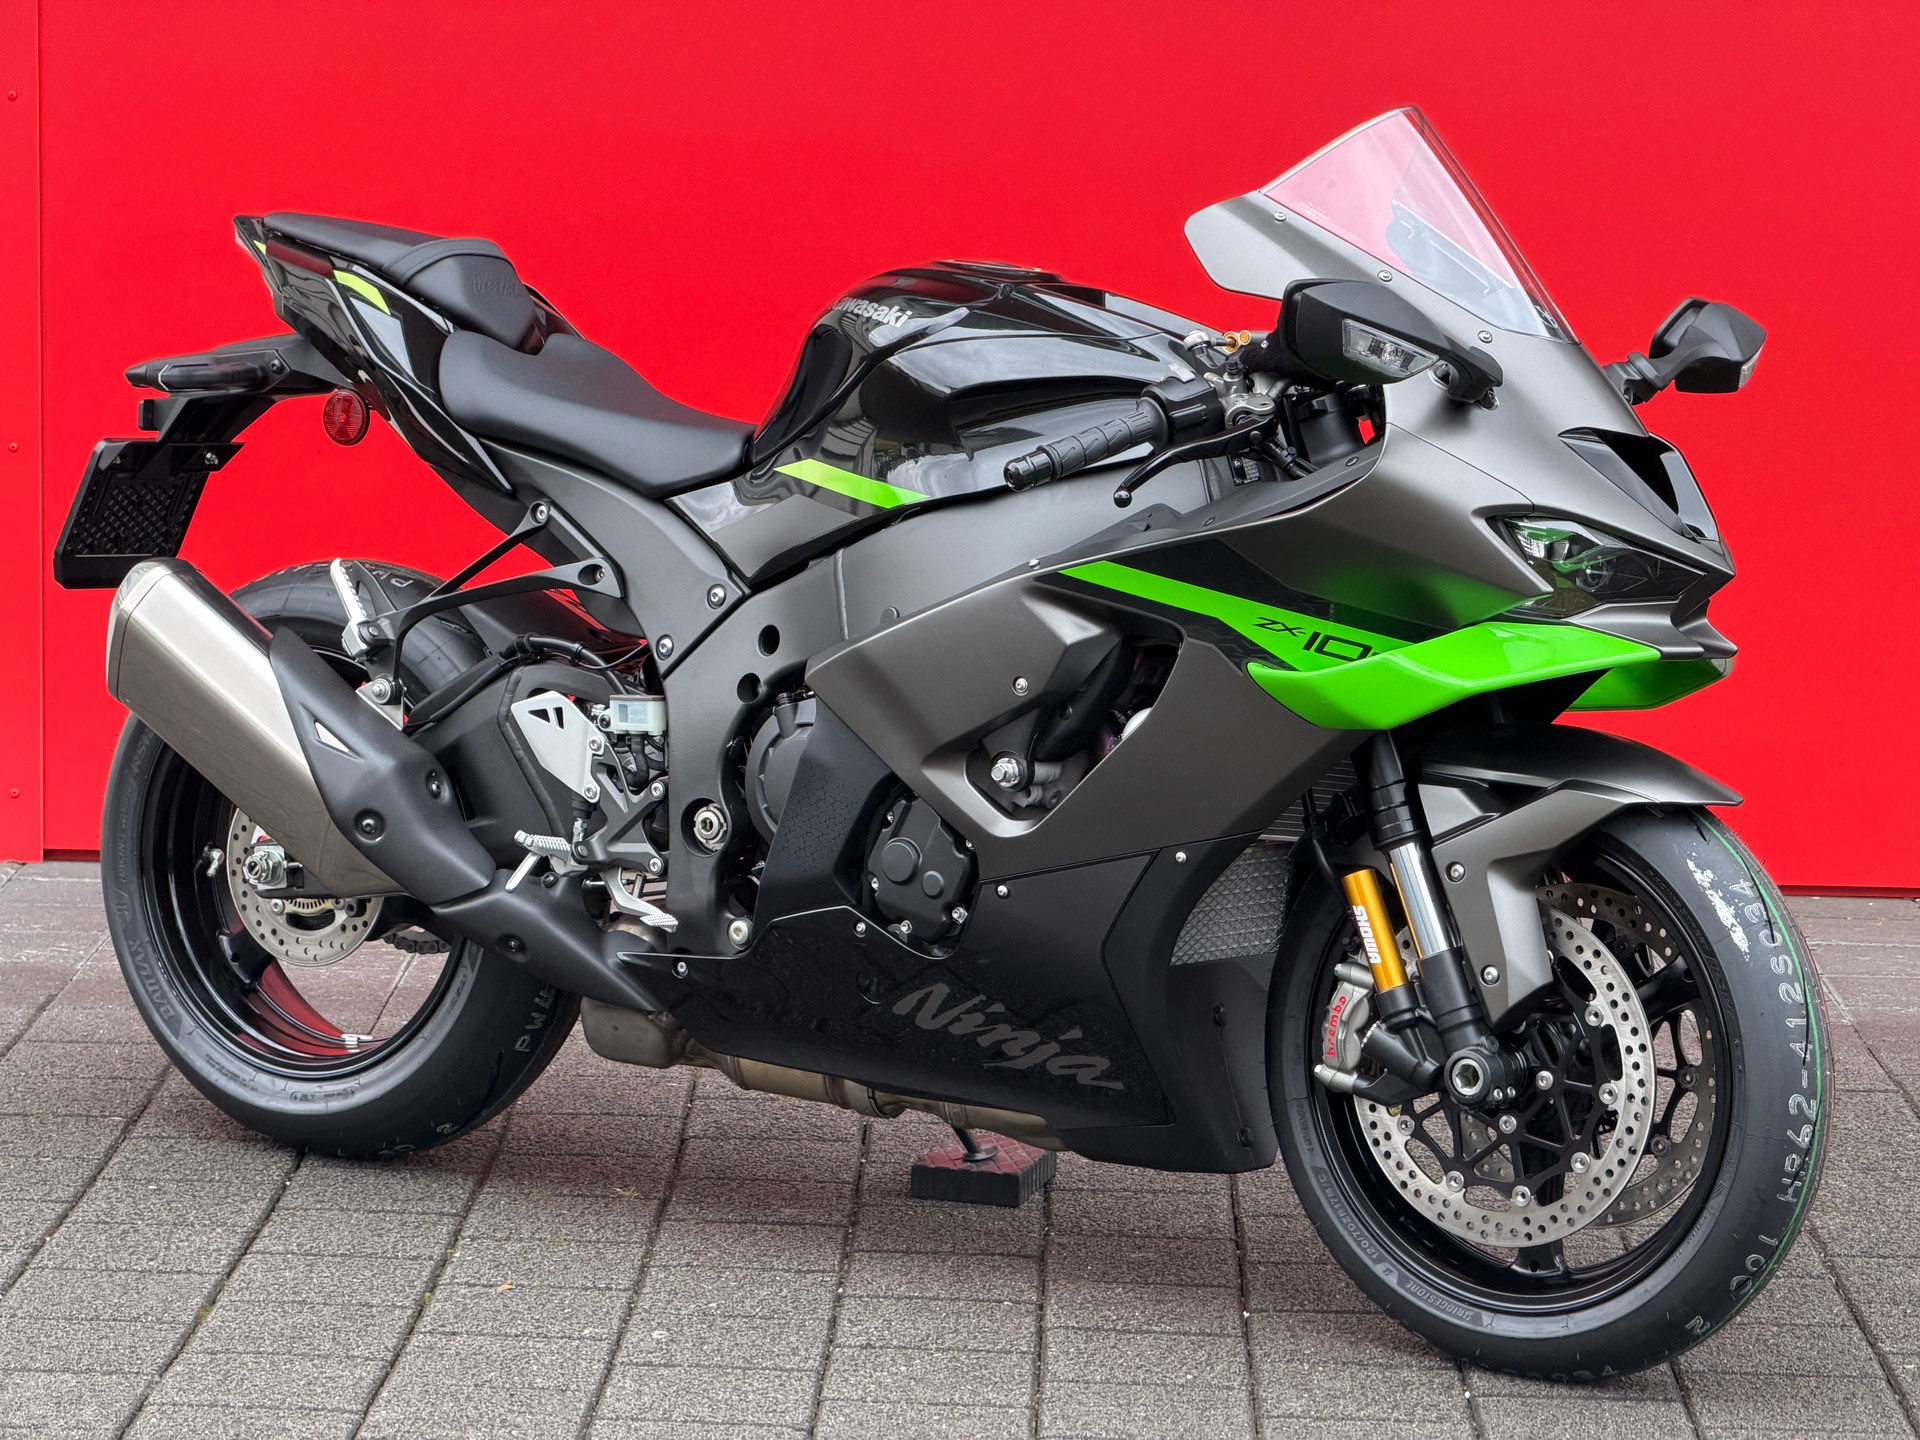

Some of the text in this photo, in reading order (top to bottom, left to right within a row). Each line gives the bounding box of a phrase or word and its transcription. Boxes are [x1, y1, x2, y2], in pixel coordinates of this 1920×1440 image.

[1353, 905, 1382, 964] SHOWA
[892, 983, 1124, 1090] Ninja
[1326, 996, 1347, 1057] brembo
[1405, 1280, 1475, 1321] BRIDGESTONE
